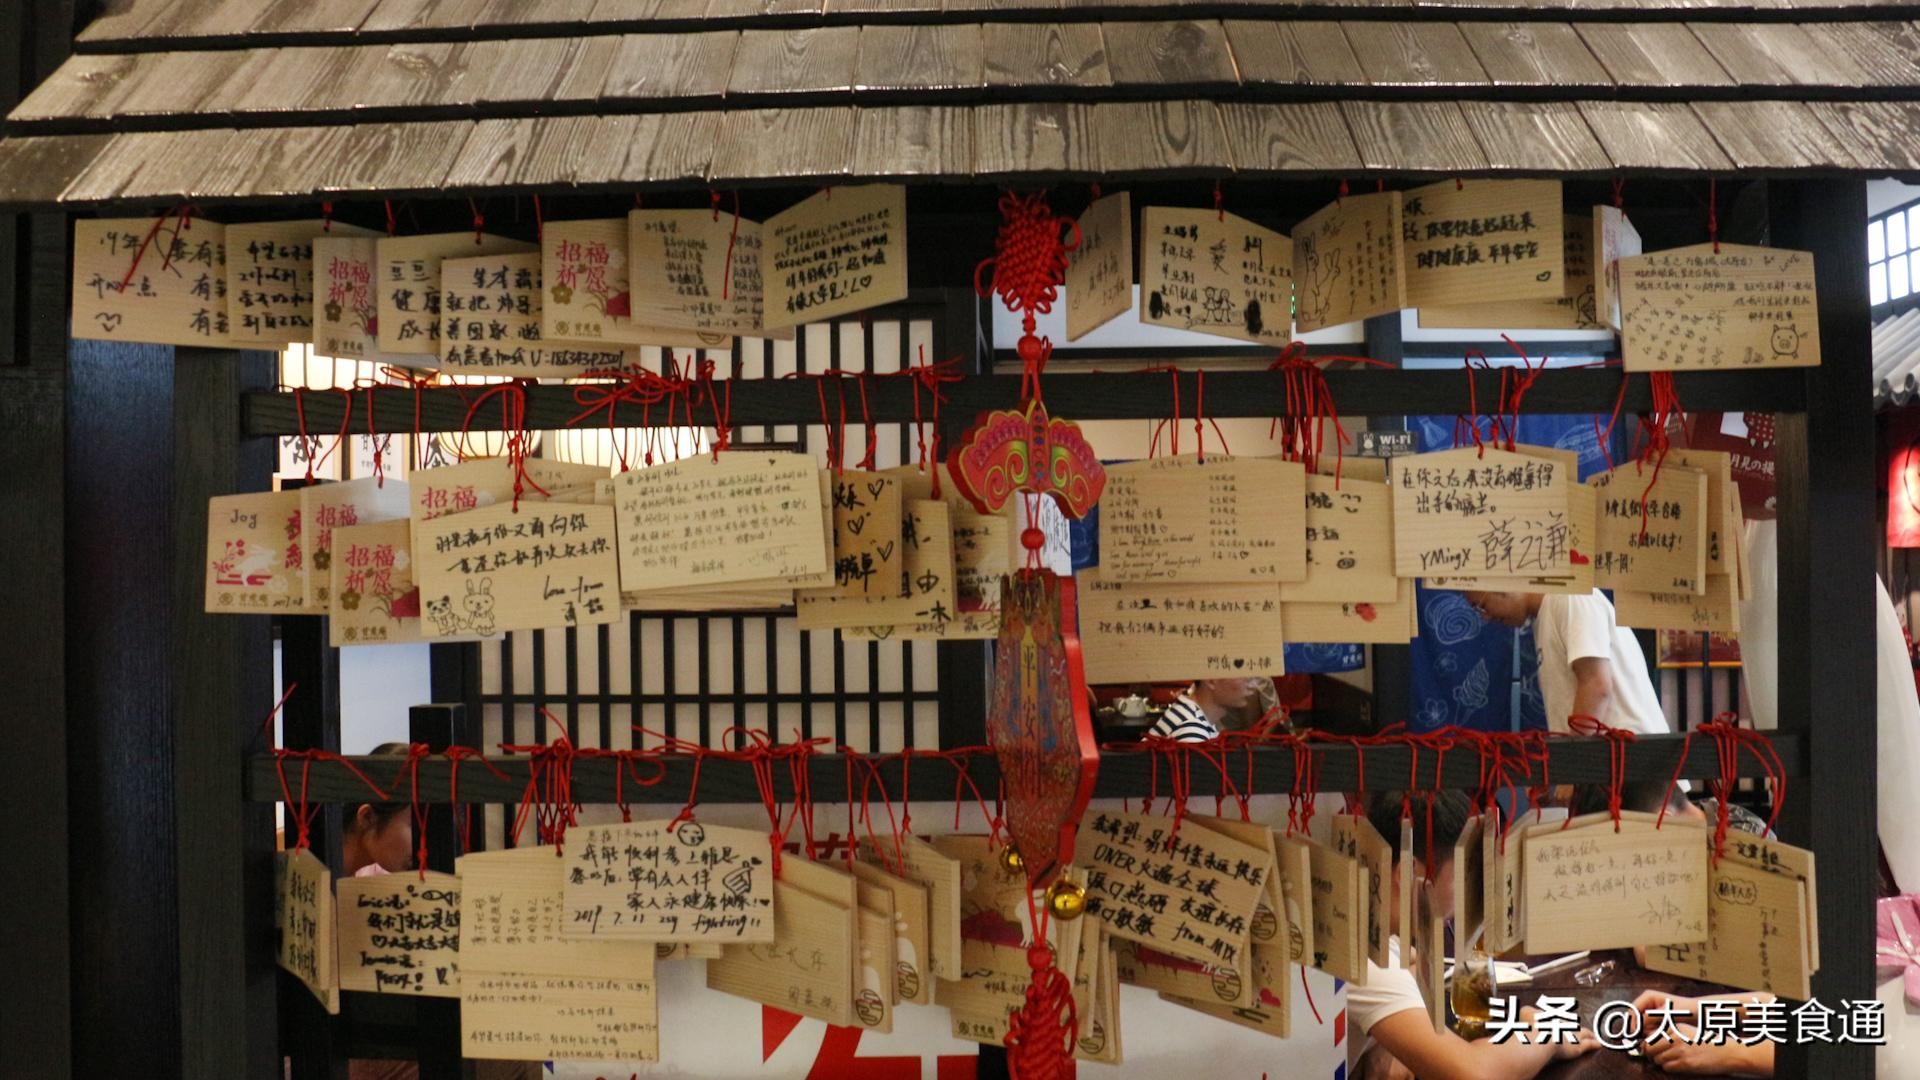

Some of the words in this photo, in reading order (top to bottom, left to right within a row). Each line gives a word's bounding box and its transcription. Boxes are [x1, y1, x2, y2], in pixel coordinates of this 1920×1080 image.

[556, 240, 609, 266] 招福
[329, 257, 371, 283] 招福
[1379, 433, 1411, 445] Wi-Fi
[421, 485, 477, 509] 招福
[231, 509, 257, 529] Joy
[316, 504, 358, 526] 招福
[345, 543, 395, 568] 招福
